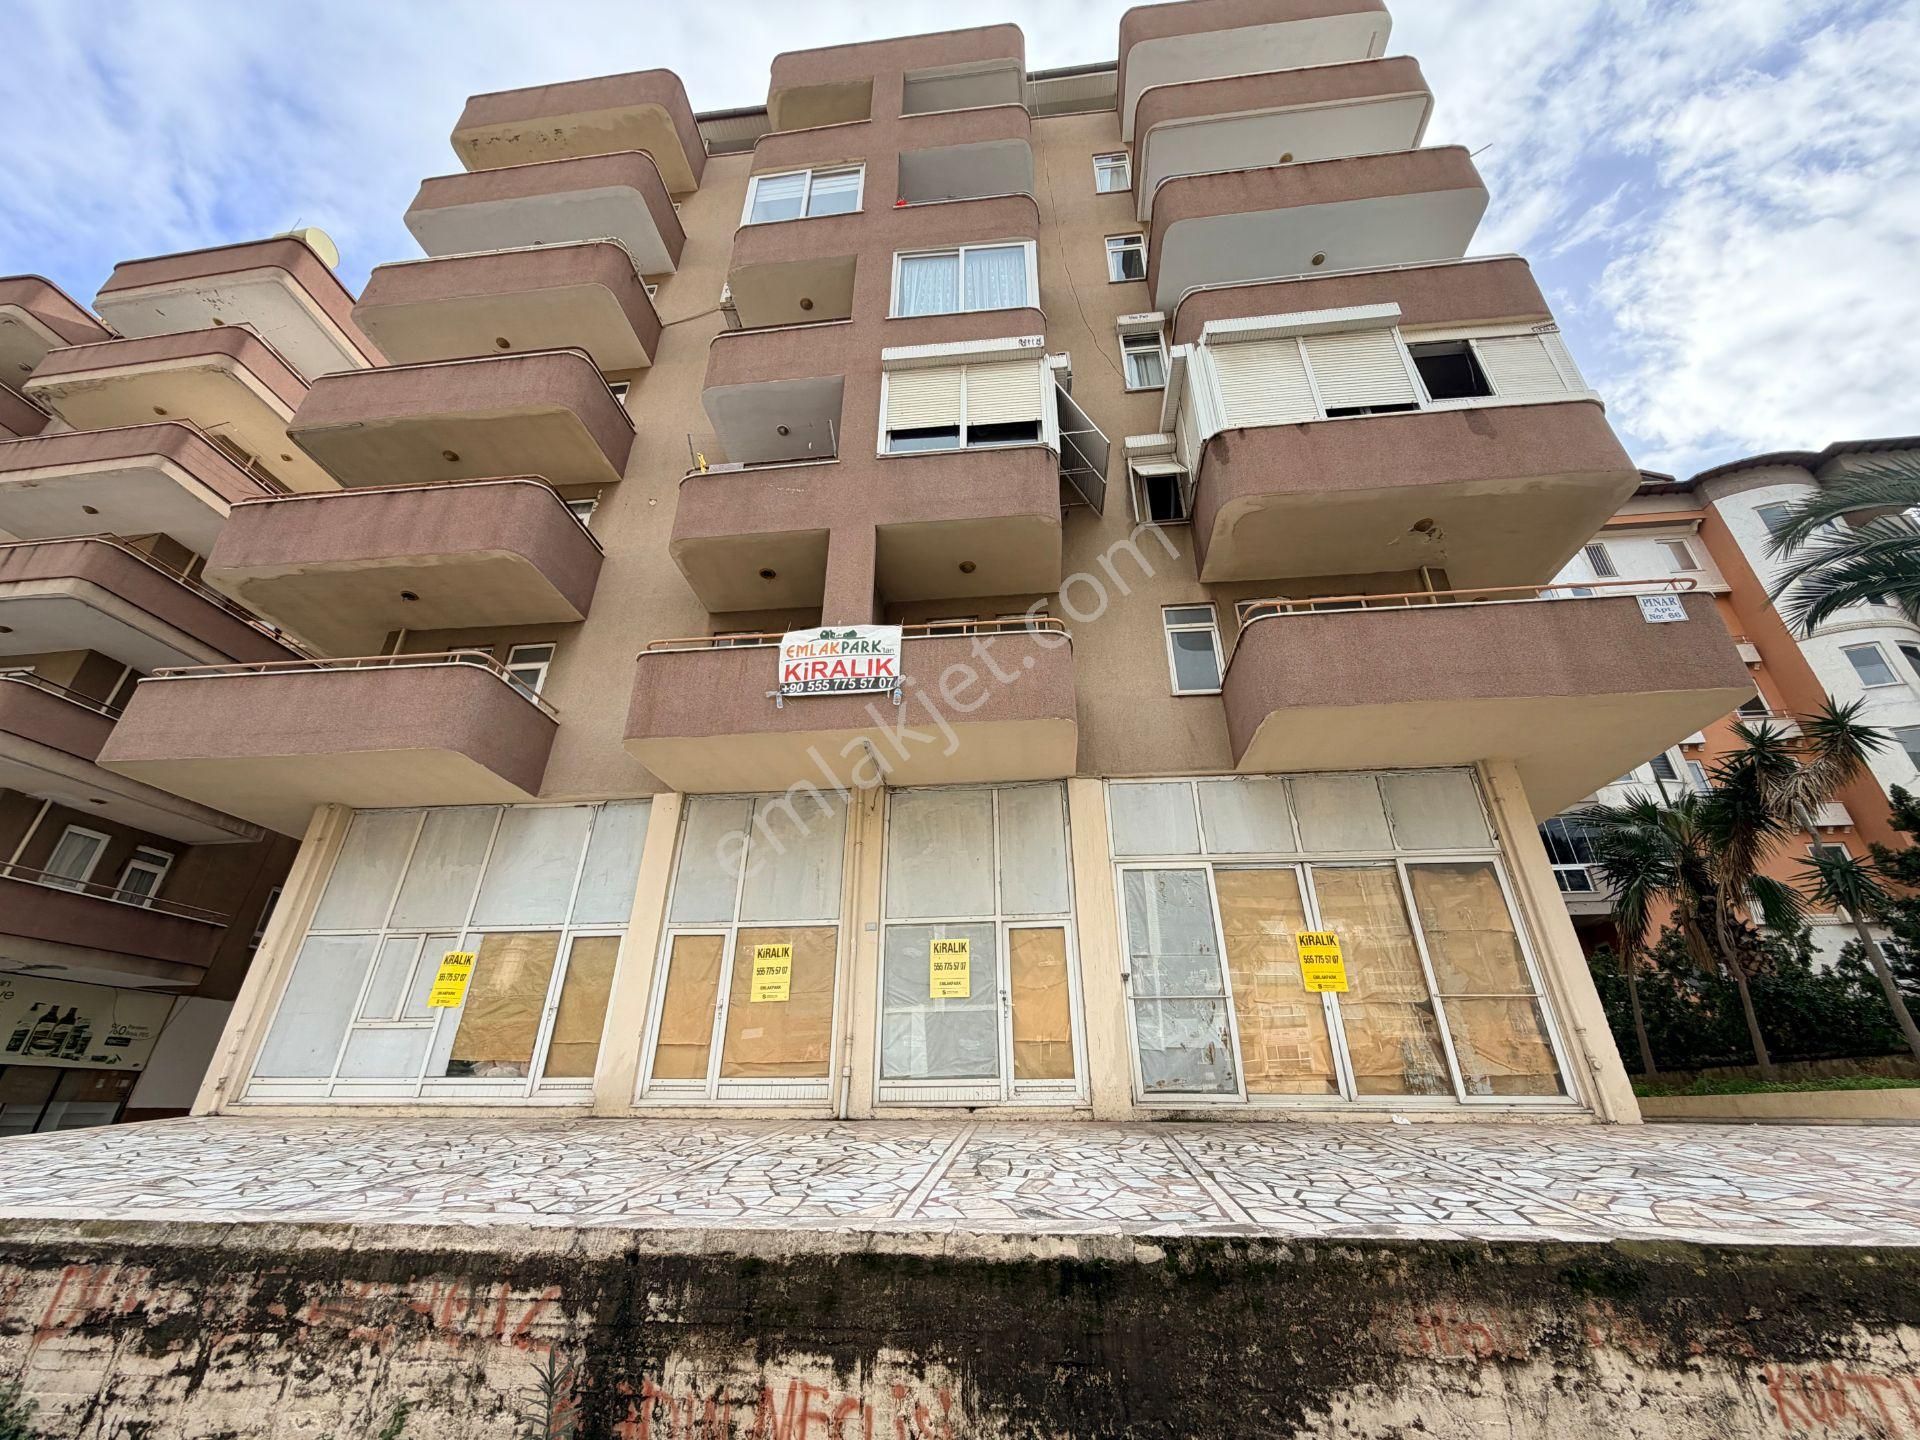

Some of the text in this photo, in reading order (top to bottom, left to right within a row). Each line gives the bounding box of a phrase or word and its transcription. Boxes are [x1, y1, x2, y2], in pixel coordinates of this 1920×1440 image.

[1641, 596, 1678, 607] PINAR
[786, 640, 881, 658] EMLAKPARK
[782, 677, 894, 693] +90 555 775 57 07
[443, 954, 474, 965] KRALIK
